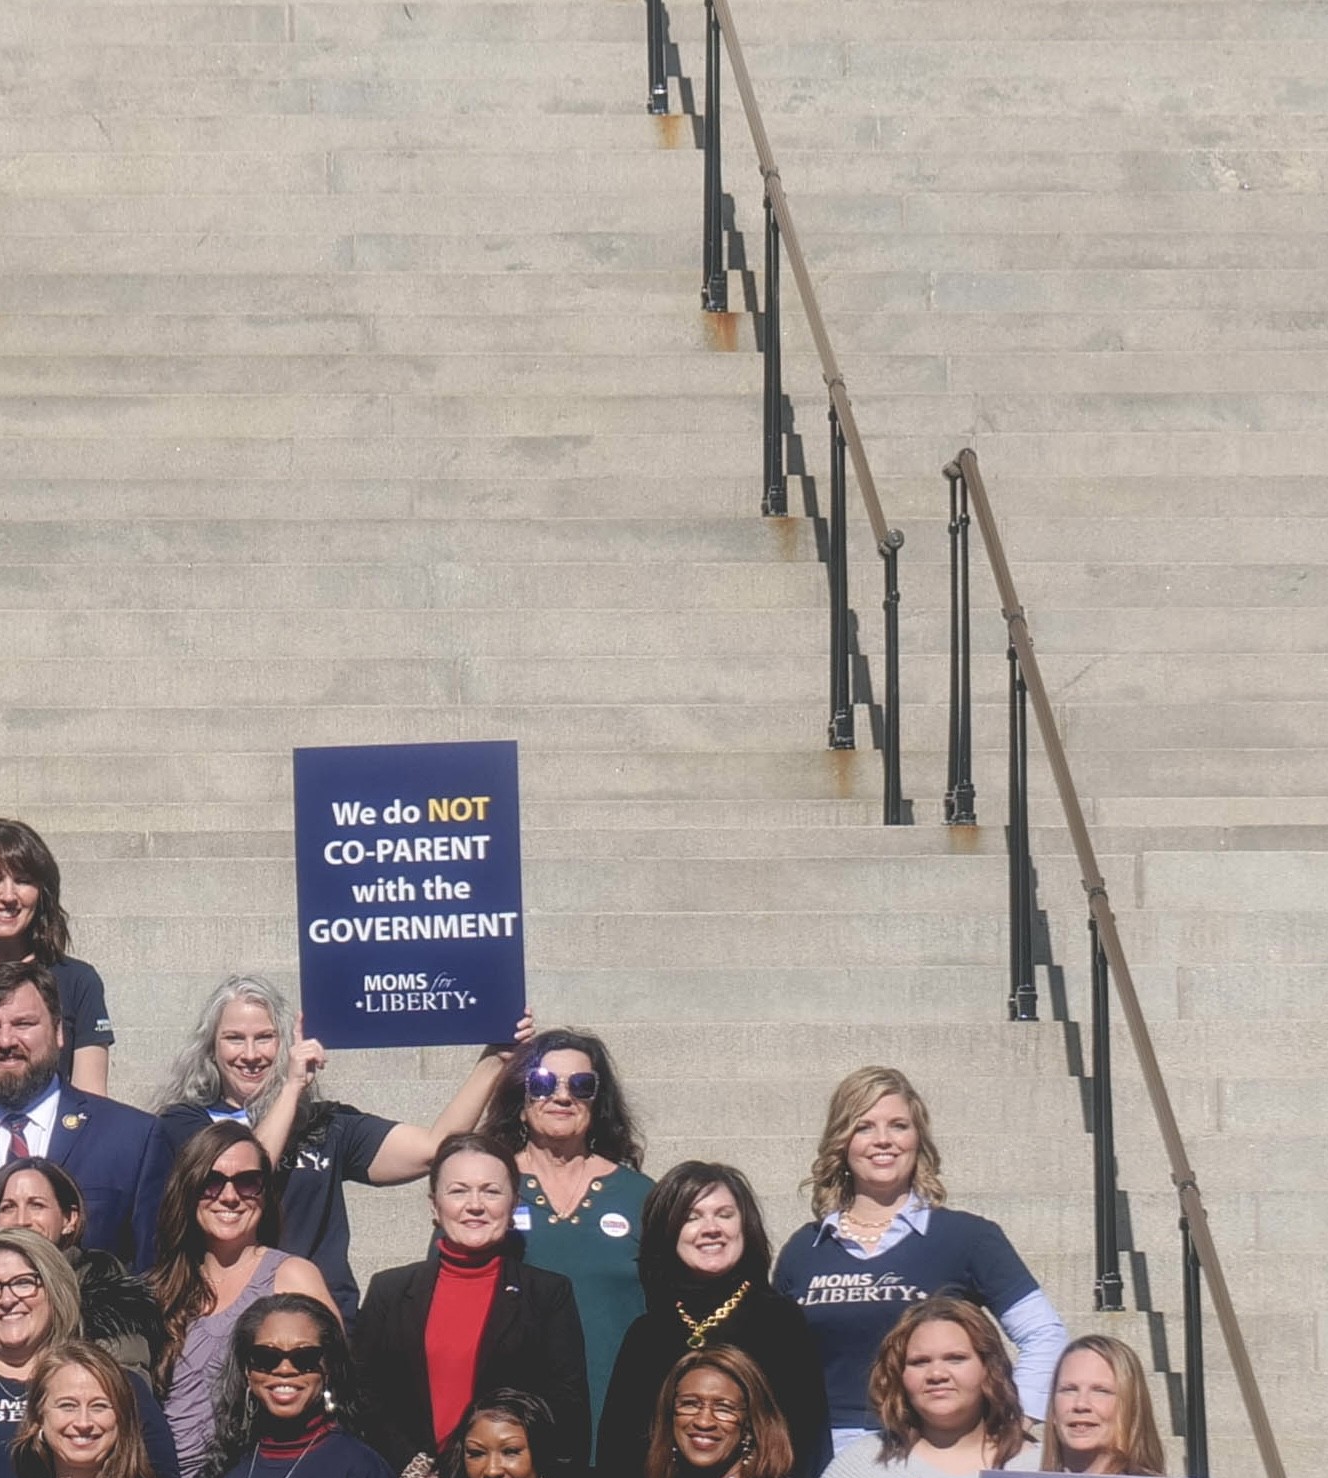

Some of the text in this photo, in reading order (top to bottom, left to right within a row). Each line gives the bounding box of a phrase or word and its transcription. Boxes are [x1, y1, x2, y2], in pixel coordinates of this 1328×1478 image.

[332, 796, 490, 826] We do NOT
[324, 835, 490, 865] CO-PARENT
[352, 875, 471, 903] with the
[309, 912, 517, 943] GOVERNMENT
[364, 972, 456, 992] MOMS for
[366, 991, 469, 1012] LIBERTY
[809, 1272, 904, 1289] MOMS for
[804, 1285, 917, 1306] LIBERTY
